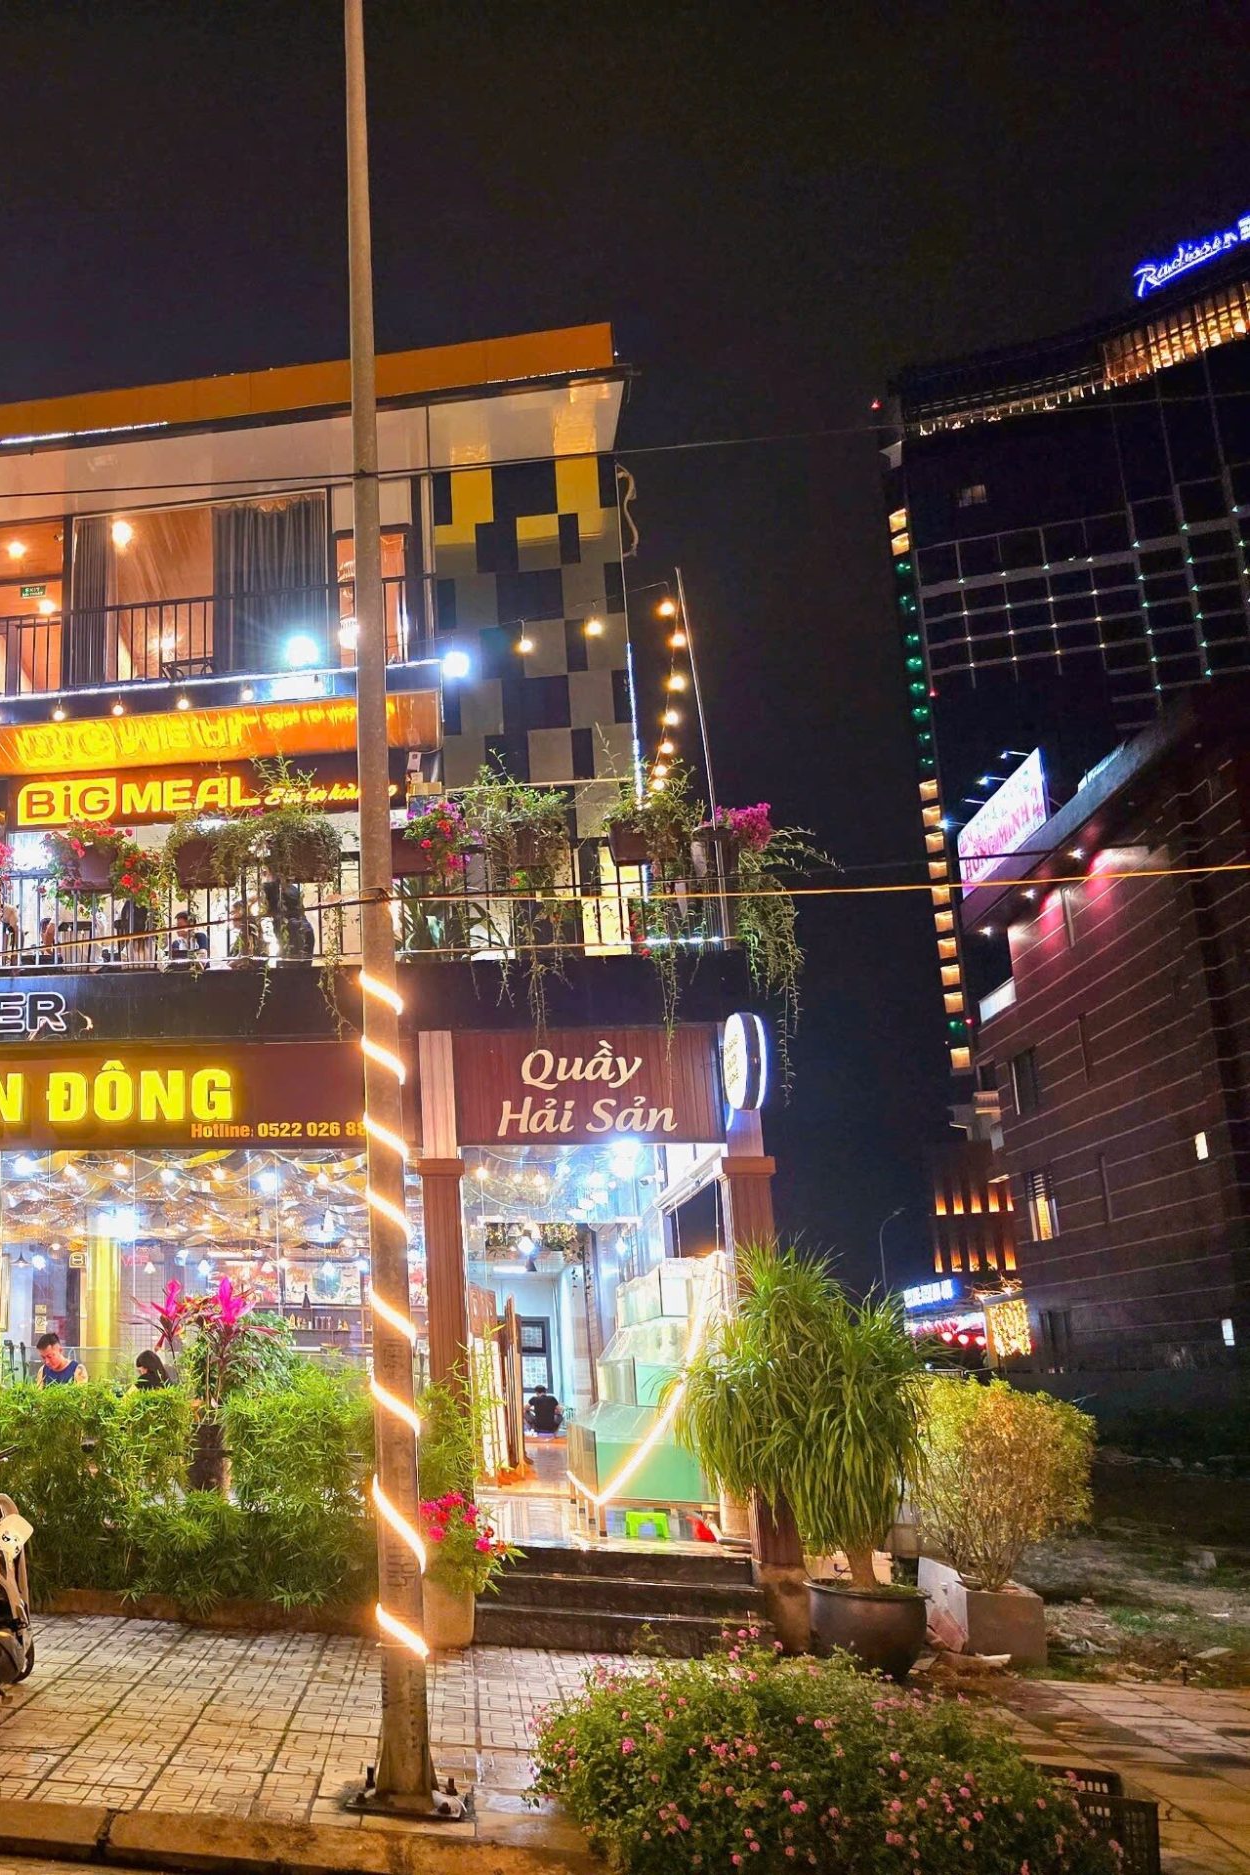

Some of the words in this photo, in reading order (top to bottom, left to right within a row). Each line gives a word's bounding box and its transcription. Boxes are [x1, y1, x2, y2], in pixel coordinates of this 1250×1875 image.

[1134, 232, 1238, 297] Radisson
[121, 776, 262, 815] MEAL
[521, 1040, 642, 1090] Quầy
[46, 1060, 233, 1122] ĐÔNG
[258, 1122, 302, 1137] 0522
[307, 1121, 340, 1137] 026
[497, 1096, 575, 1136] Hải
[586, 1096, 677, 1133] Sản
